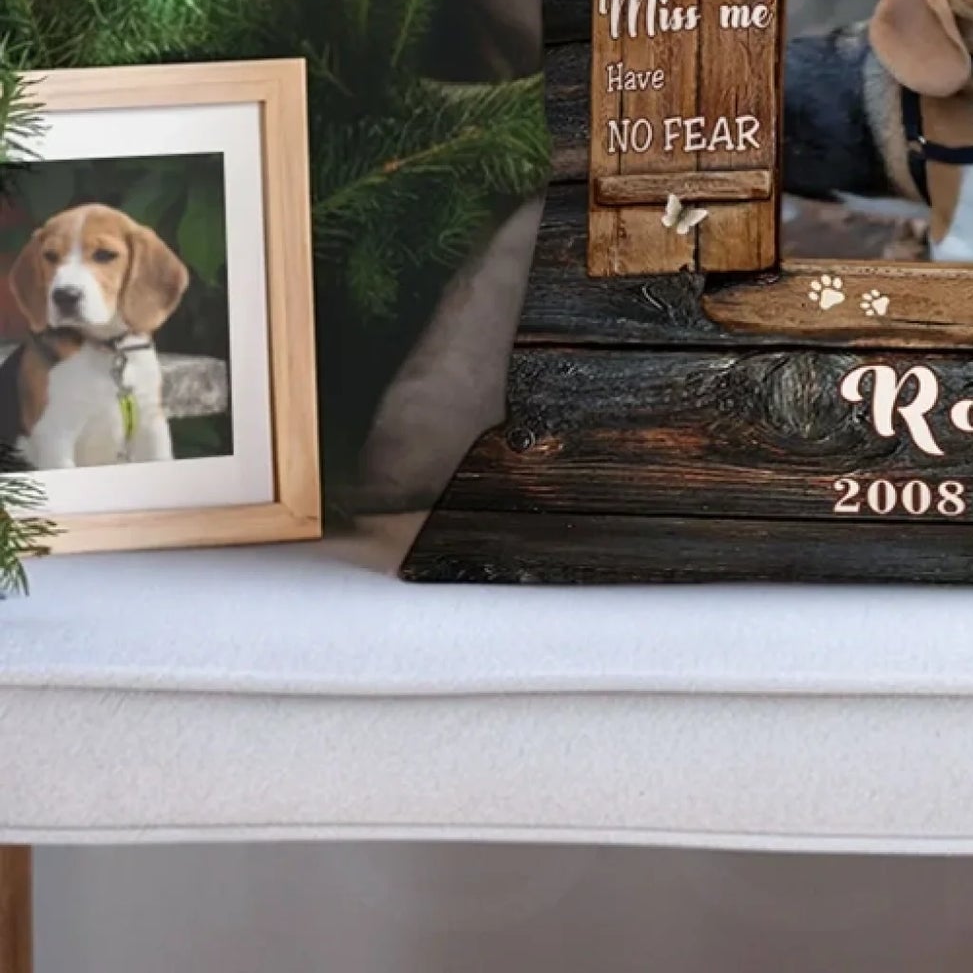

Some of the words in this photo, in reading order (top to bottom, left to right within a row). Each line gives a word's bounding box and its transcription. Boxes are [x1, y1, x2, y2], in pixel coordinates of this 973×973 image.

[720, 5, 773, 29] me
[607, 63, 665, 92] Have
[608, 118, 652, 153] NO
[663, 115, 760, 152] FEAR
[833, 479, 966, 516] 2008
